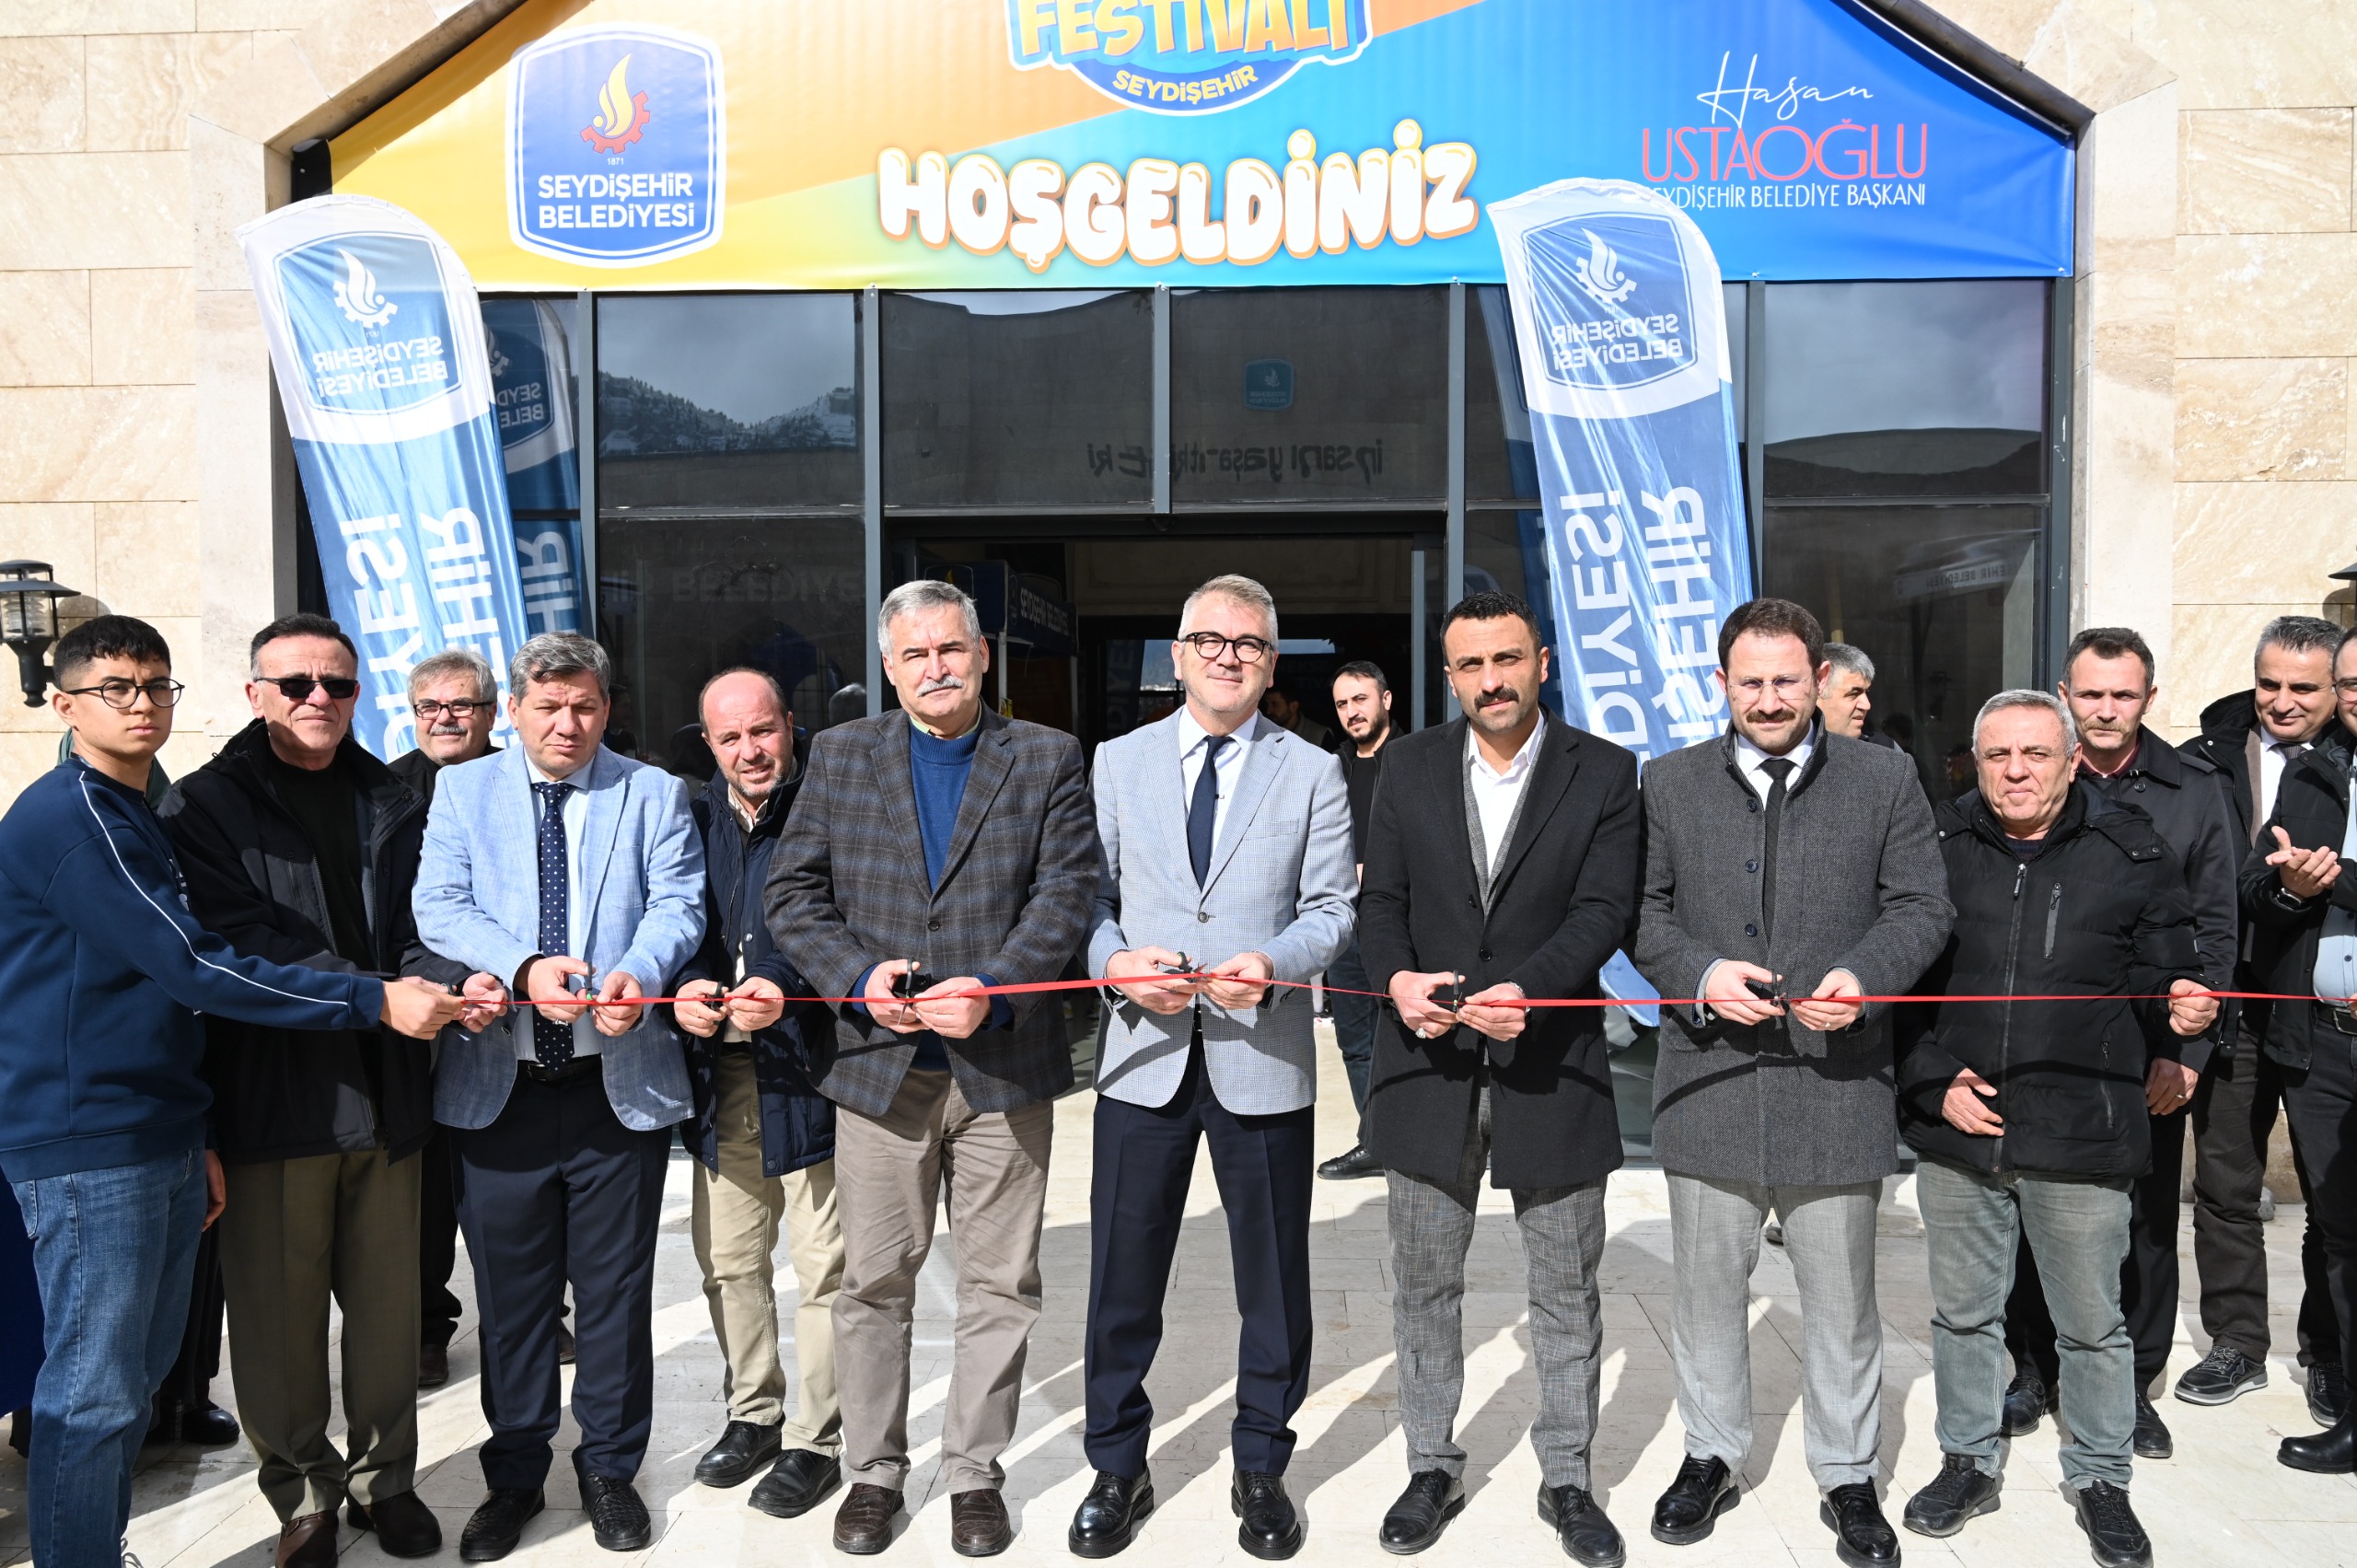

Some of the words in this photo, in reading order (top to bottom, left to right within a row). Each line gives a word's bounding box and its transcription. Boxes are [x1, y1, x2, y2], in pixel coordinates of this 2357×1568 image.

[1112, 64, 1259, 105] SEYDİŞEHİR
[1696, 50, 1874, 130] Hasan
[607, 157, 624, 166] 1871
[1642, 118, 1928, 182] USTAOĞLU
[538, 172, 693, 203] SEYDİŞEHİR
[877, 119, 1480, 273] HOŞGELDİNİZ
[1751, 182, 1840, 208] BELEDİYE
[1847, 182, 1926, 209] BAŞKANI
[539, 202, 694, 229] BELEDİYESİ
